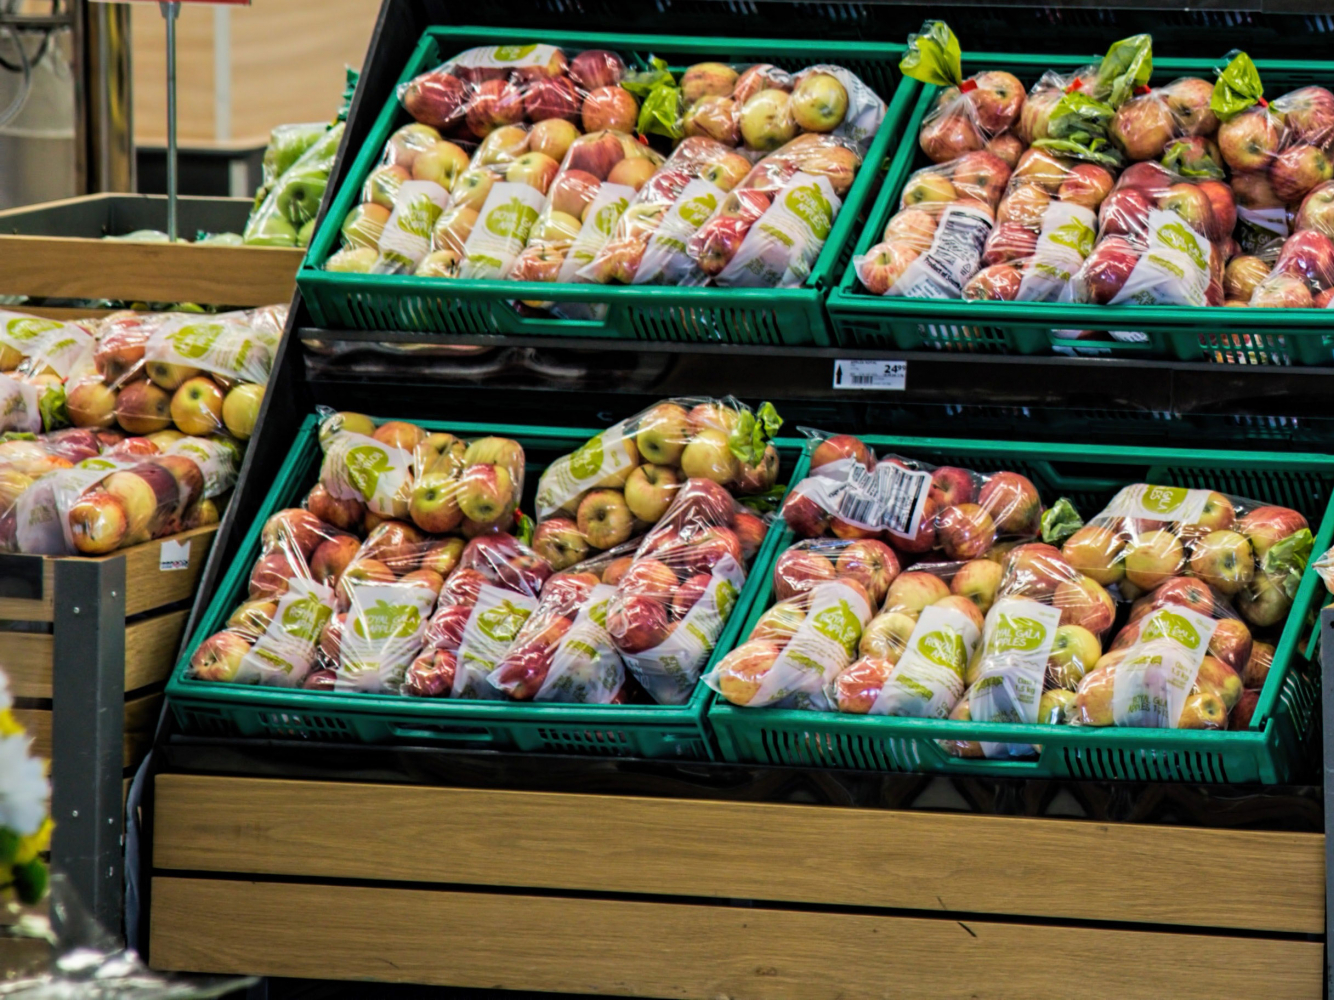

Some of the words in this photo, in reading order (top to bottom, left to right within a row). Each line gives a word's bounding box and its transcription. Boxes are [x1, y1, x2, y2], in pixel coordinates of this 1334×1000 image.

[791, 188, 818, 214] ROYAL
[795, 200, 825, 231] APPLES
[1015, 629, 1041, 641] GALA
[1181, 671, 1189, 681] kg
[1015, 684, 1024, 693] 1.5
[1025, 685, 1036, 695] kg
